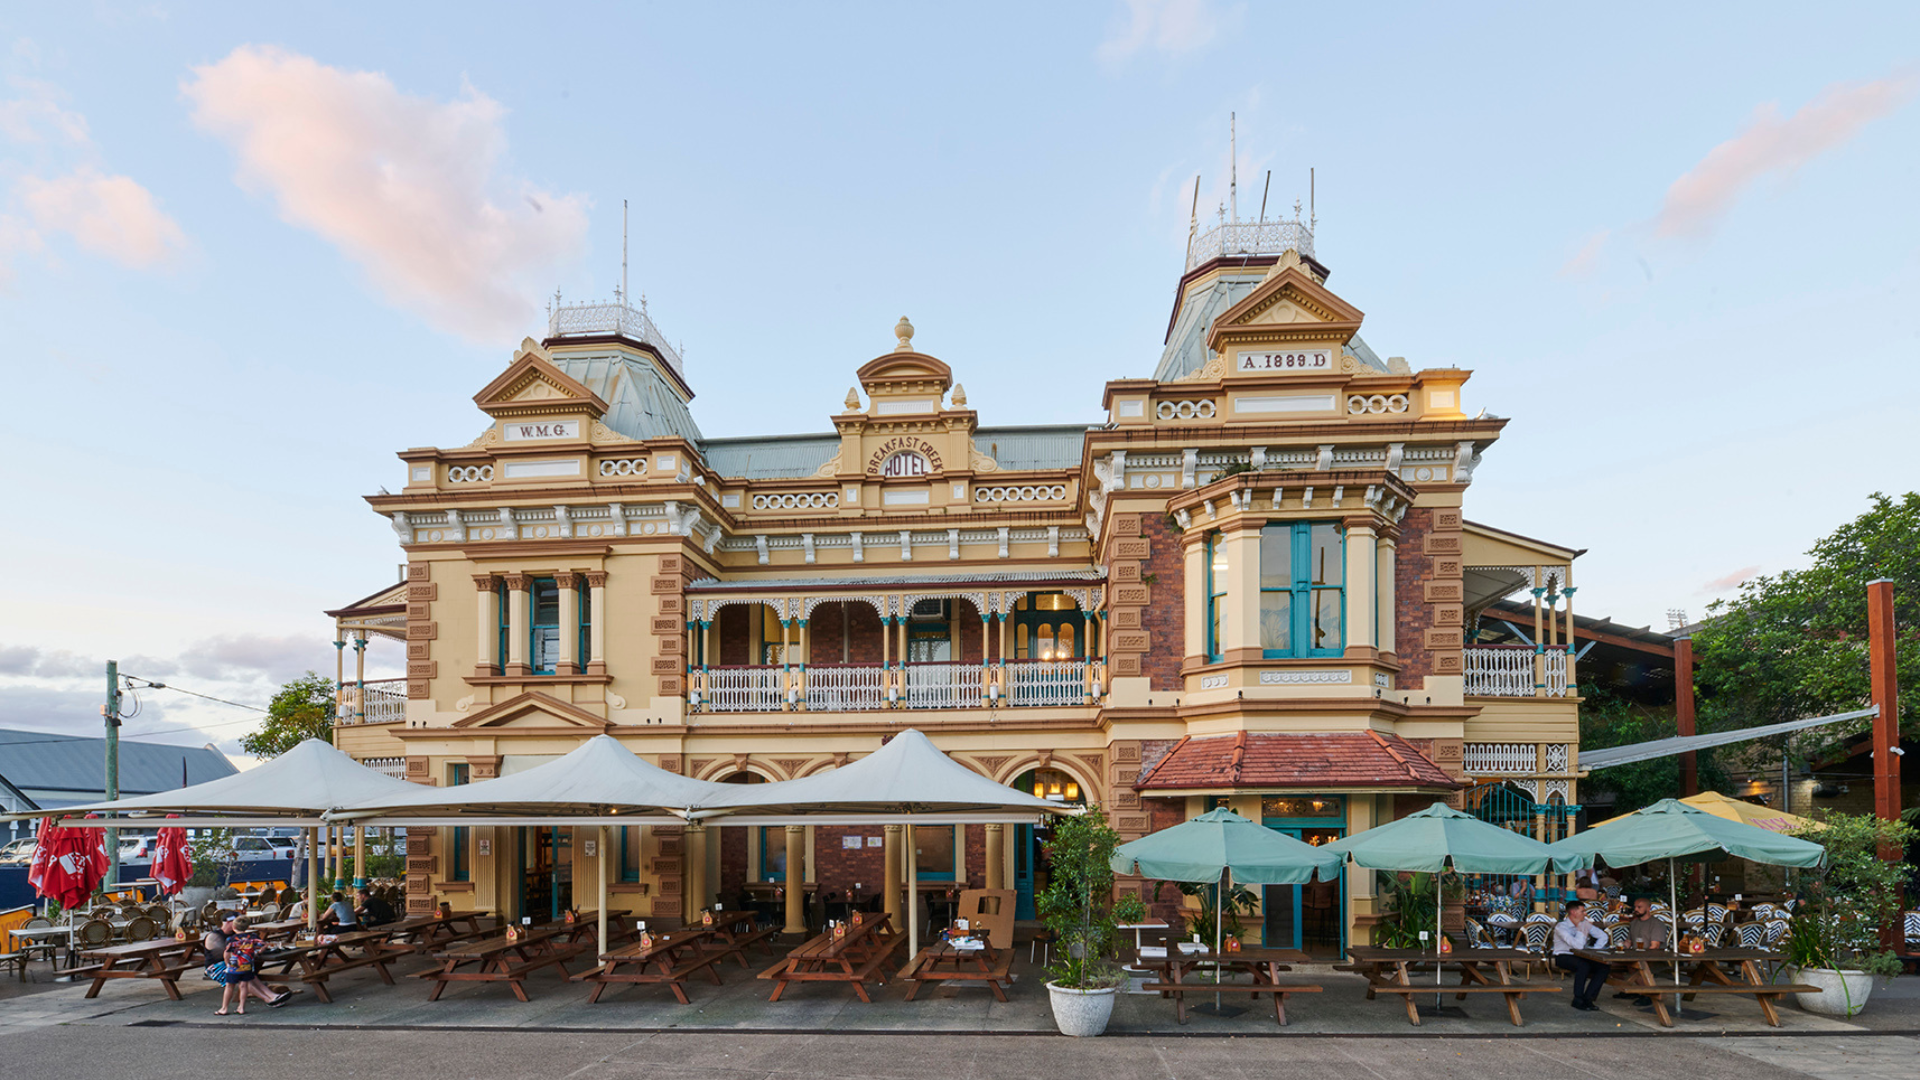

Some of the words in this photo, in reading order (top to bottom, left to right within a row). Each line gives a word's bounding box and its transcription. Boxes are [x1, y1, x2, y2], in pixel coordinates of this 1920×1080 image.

[520, 424, 569, 438] W.M.G.
[867, 436, 920, 474] BREAKFAST
[919, 441, 944, 472] CREEK
[885, 452, 928, 476] HOTEL
